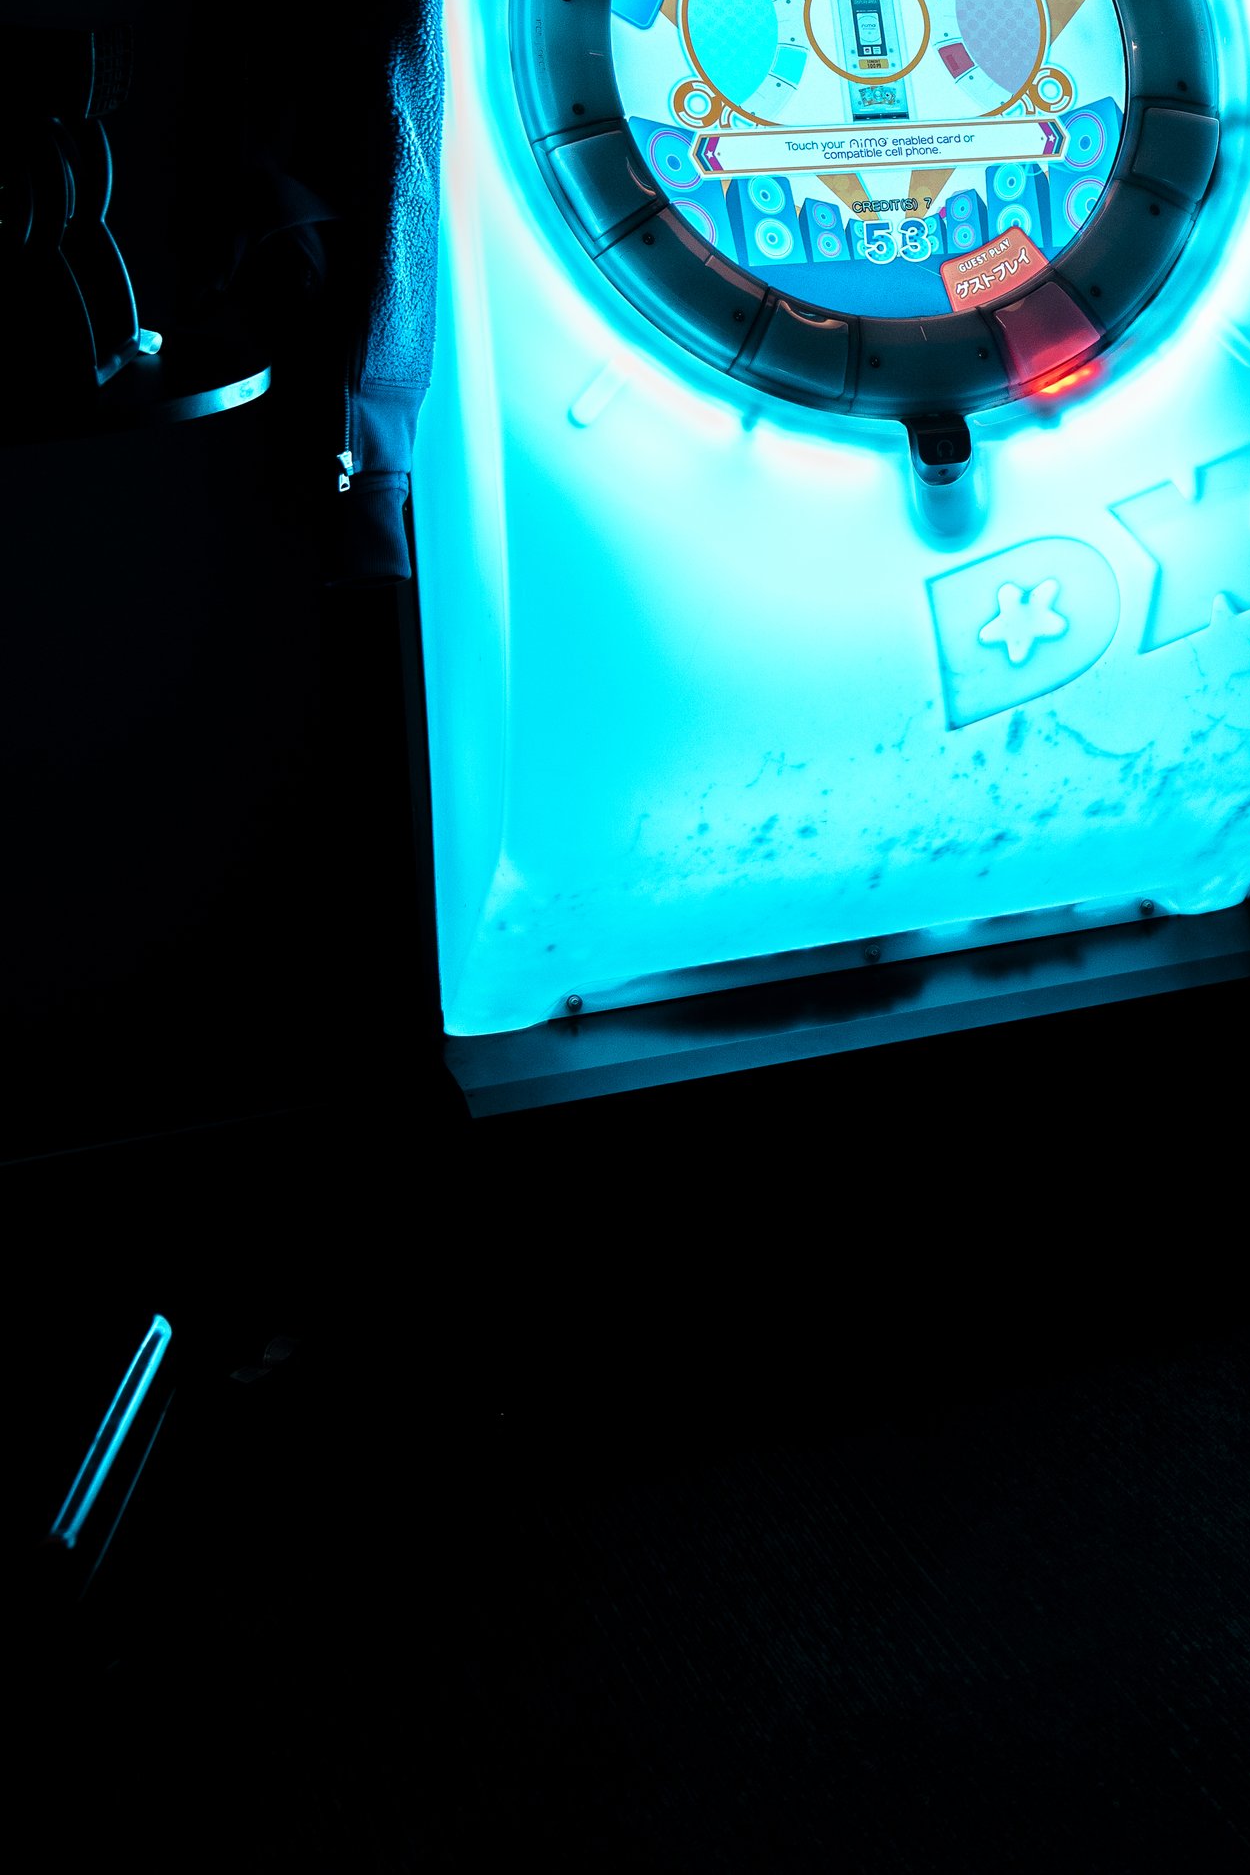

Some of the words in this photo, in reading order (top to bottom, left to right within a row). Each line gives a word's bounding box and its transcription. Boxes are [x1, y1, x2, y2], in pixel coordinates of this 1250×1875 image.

[785, 140, 819, 151] Touch
[821, 140, 846, 152] your
[892, 135, 934, 147] enabled
[936, 133, 961, 144] card
[963, 134, 976, 143] or
[824, 147, 883, 161] compatible
[885, 146, 904, 158] cell
[905, 145, 942, 158] phone.
[851, 198, 918, 214] CREDIT(S)
[923, 197, 933, 209] 7
[863, 217, 932, 264] 53
[958, 252, 988, 273] GUEST
[988, 238, 1012, 258] PLAY
[955, 247, 1031, 299] ゲストプレイ
